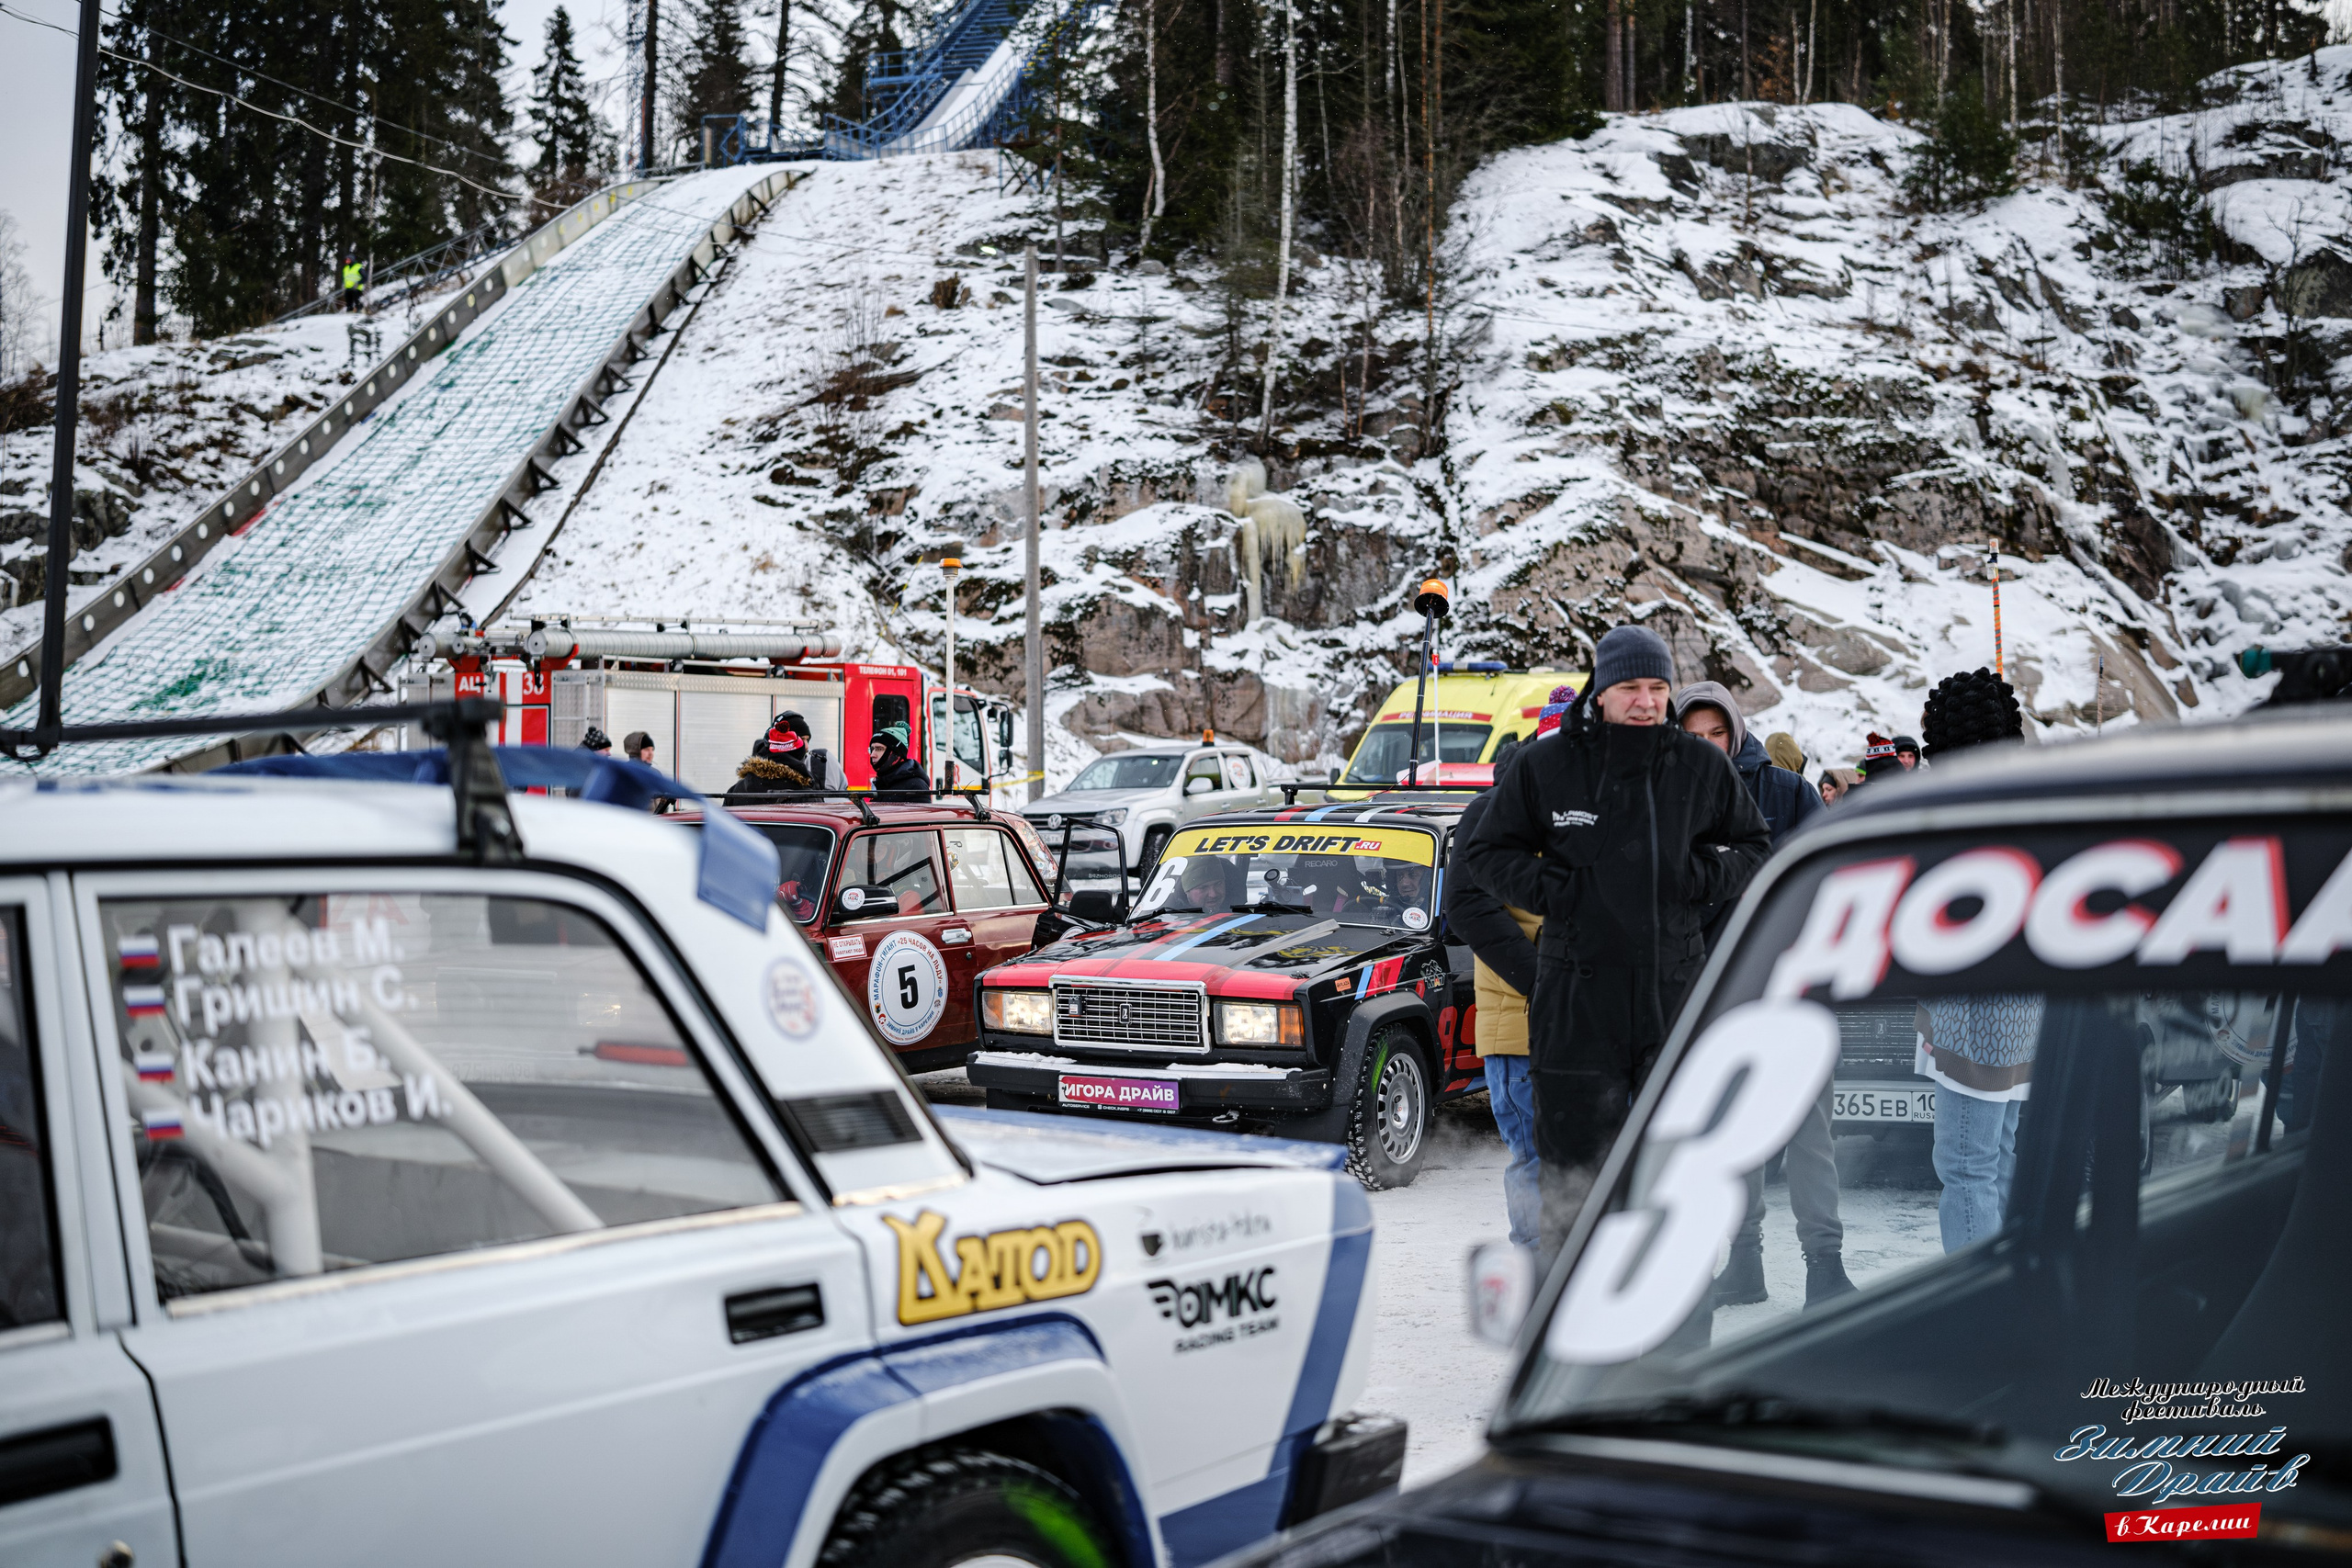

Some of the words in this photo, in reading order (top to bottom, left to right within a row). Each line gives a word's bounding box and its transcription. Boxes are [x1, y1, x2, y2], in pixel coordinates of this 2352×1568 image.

[859, 666, 888, 675] ТЕЛЕФОН
[1398, 710, 1474, 719] РЕНИМАЦИЯ
[1194, 835, 1270, 852] LET'S
[1305, 860, 1338, 868] RECARO
[1137, 856, 1188, 911] 6
[908, 937, 927, 952] ЧАСОВ
[927, 949, 935, 959] НА
[898, 964, 919, 1010] 5
[182, 1038, 336, 1091] Канин
[1066, 1083, 1115, 1099] ИГОРА
[1119, 1085, 1174, 1101] ДРАЙВ
[1544, 998, 1838, 1366] 3
[1239, 1317, 1281, 1337] TEAM
